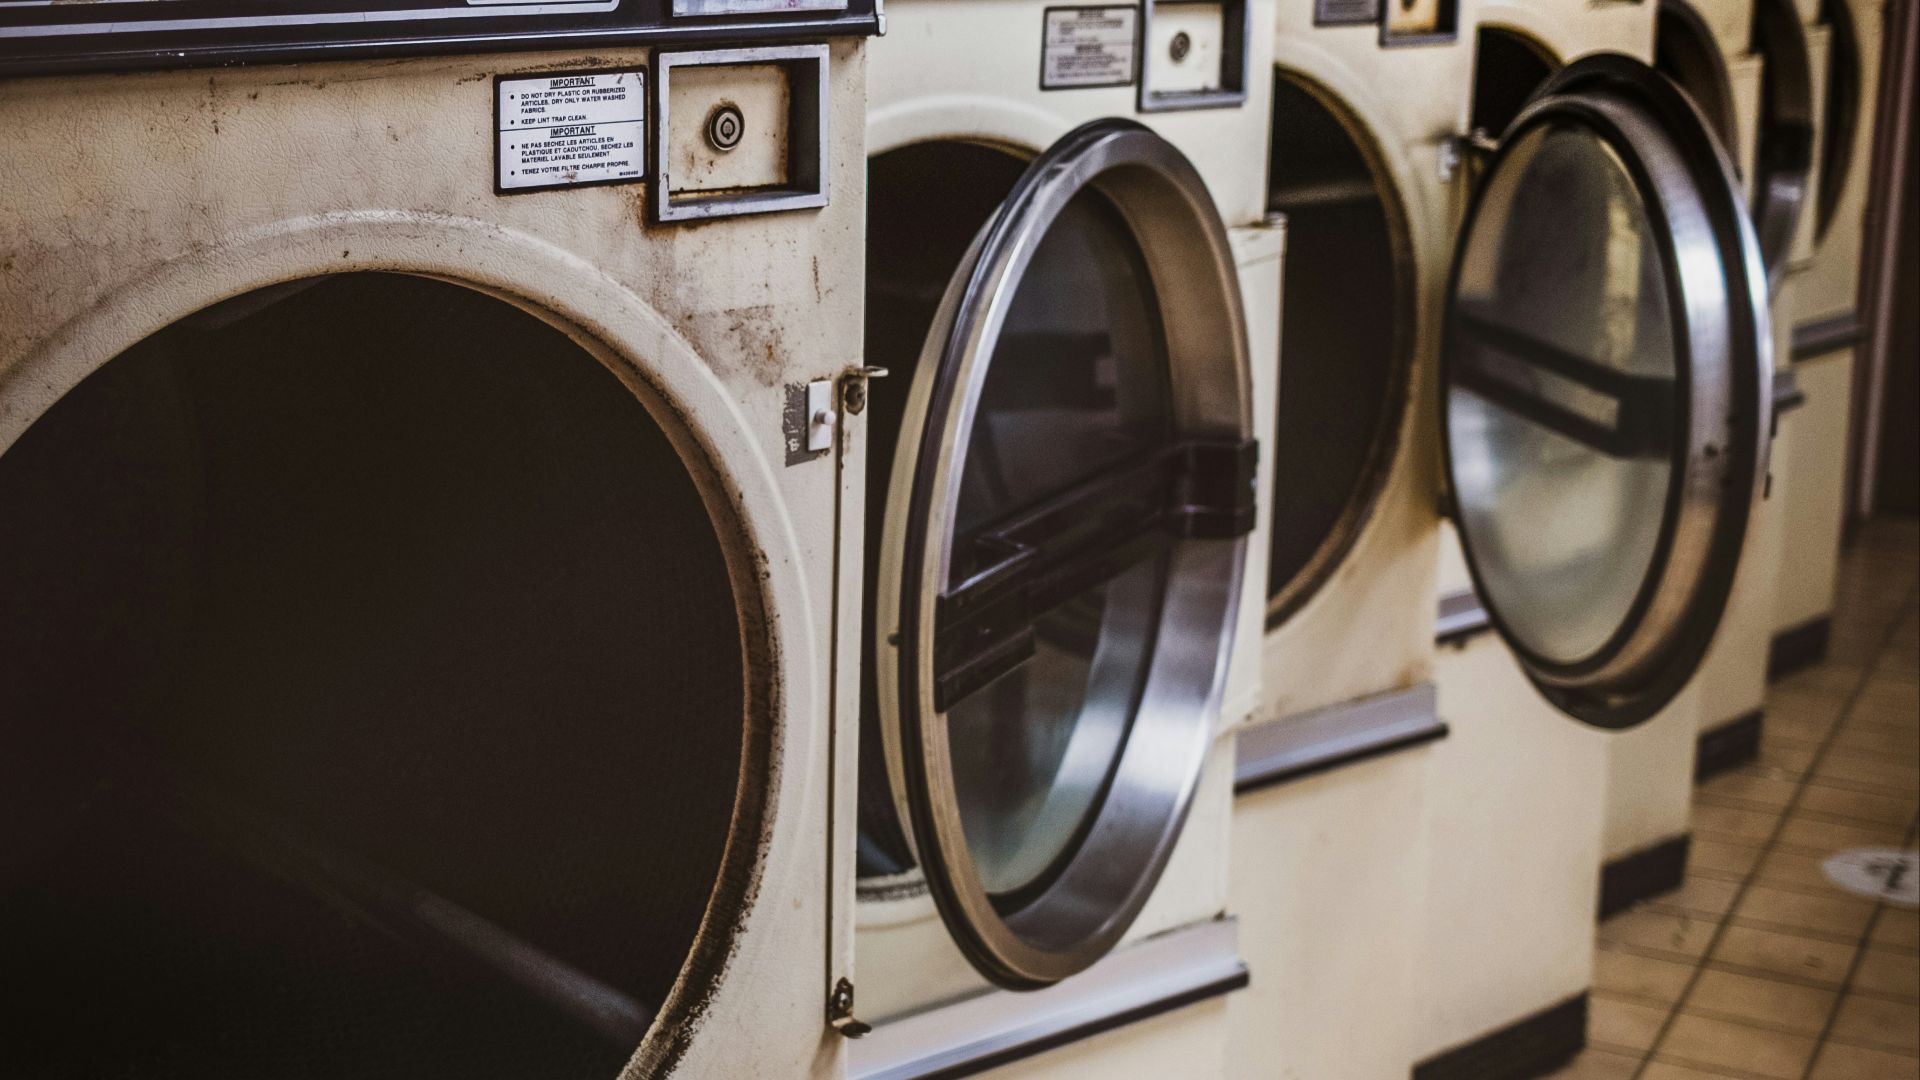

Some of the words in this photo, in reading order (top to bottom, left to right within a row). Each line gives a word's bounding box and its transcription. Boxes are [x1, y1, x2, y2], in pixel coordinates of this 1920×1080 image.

[550, 77, 595, 87] IMPORTANT
[591, 87, 626, 95] RUBBERIZED
[550, 126, 596, 136] IMPORTANT
[543, 140, 565, 148] SECHEZ
[579, 137, 605, 145] ARTICLES
[577, 151, 610, 159] SEULEMENT
[581, 162, 606, 170] CHARPIE
